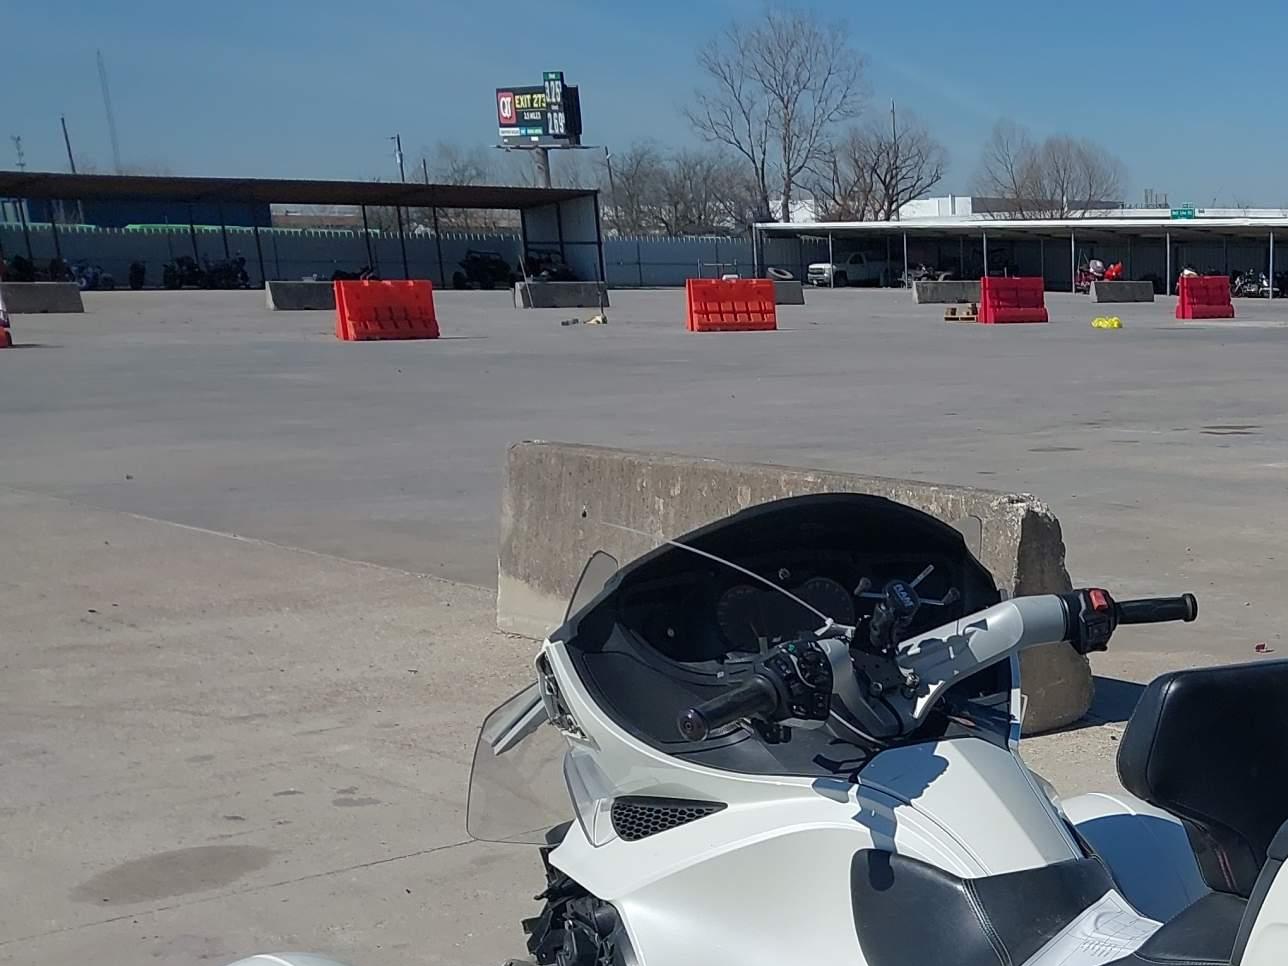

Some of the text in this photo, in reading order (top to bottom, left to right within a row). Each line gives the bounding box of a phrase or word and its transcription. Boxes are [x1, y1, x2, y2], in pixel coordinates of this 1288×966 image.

[500, 96, 513, 118] QT
[515, 94, 531, 108] EXIT
[533, 93, 546, 107] 273
